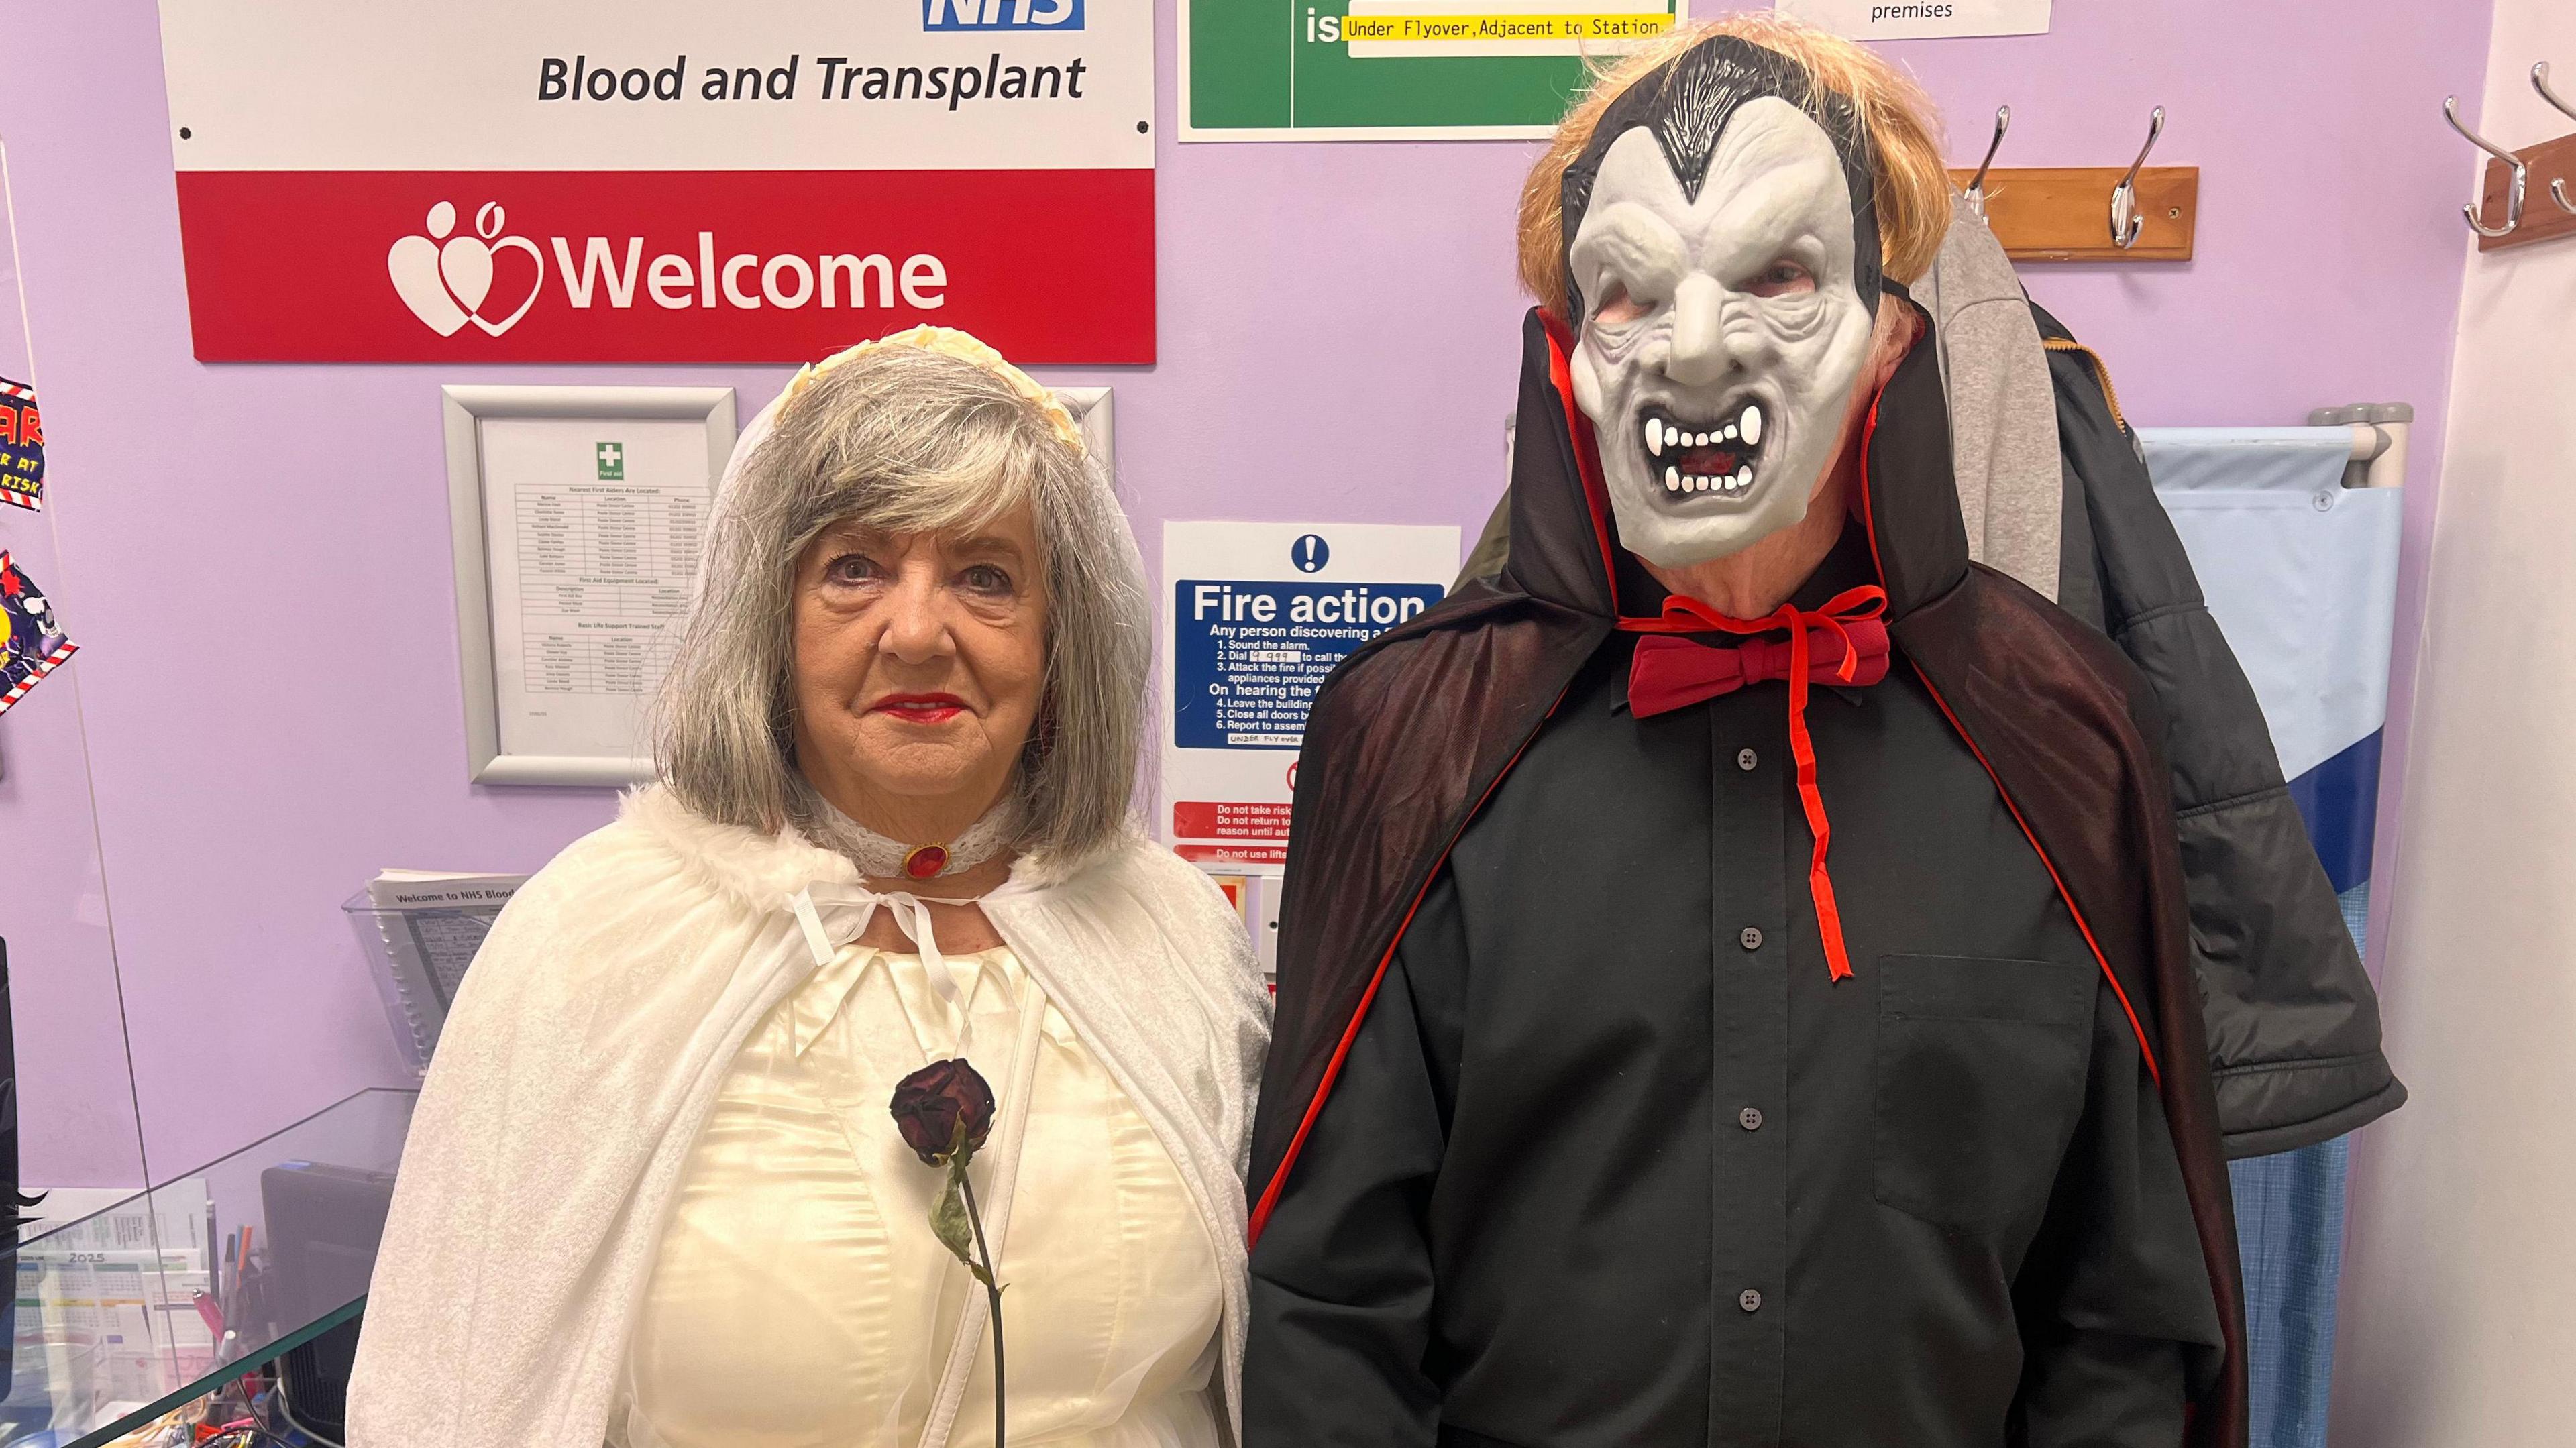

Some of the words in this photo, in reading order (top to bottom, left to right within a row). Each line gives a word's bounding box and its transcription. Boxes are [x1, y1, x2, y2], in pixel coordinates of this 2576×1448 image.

[1872, 1, 1953, 23] premises
[1307, 8, 1340, 42] is
[1348, 20, 1393, 36] Under
[1564, 21, 1582, 36] to
[537, 55, 686, 101] Blood
[701, 54, 799, 101] and
[816, 53, 1086, 111] Transplant
[551, 231, 947, 309] Welcome
[17, 457, 39, 472] AT
[2, 474, 40, 494] RISK
[1194, 585, 1277, 622] Fire
[1290, 587, 1426, 624] action
[1210, 625, 1236, 638] Any
[1240, 628, 1287, 639] person
[1290, 626, 1369, 642] discovering
[1218, 641, 1226, 649] 1.
[1229, 641, 1260, 650] Sound
[1262, 641, 1277, 650] the
[1280, 641, 1310, 651] alarm.
[1217, 651, 1226, 660] 2.
[1229, 651, 1247, 661] Dial
[1302, 653, 1312, 661] to
[1315, 652, 1332, 662] call
[1217, 663, 1226, 671] 3.
[1229, 663, 1259, 672] Attack
[1261, 663, 1277, 672] the
[1279, 663, 1295, 673] fire
[1297, 663, 1305, 673] if
[1228, 674, 1280, 685] appliances
[1282, 675, 1325, 685] provided
[1209, 683, 1228, 695] On
[1236, 685, 1287, 699] hearing
[1290, 685, 1311, 697] the
[1216, 698, 1226, 708] 4.
[1227, 699, 1256, 708] Leave
[1258, 700, 1273, 708] the
[1216, 710, 1226, 718] 5.
[1227, 710, 1254, 719] Close
[1256, 710, 1268, 719] all
[1271, 710, 1298, 720] doors
[1216, 720, 1226, 729] 6.
[1227, 720, 1259, 731] Report
[1262, 722, 1271, 730] to
[1230, 734, 1259, 742] UNDER
[1217, 805, 1230, 814] Do
[1233, 805, 1248, 814] not
[1251, 805, 1271, 815] take
[1217, 816, 1230, 824] Do
[1233, 816, 1248, 825] not
[1250, 817, 1279, 826] return
[1282, 817, 1291, 826] to
[1252, 827, 1273, 836] until
[1216, 849, 1230, 858] Do
[1232, 850, 1248, 858] not
[1270, 850, 1287, 859] lifts
[396, 893, 444, 903] Welcome
[446, 893, 458, 901] to
[461, 890, 482, 900] NHS
[485, 889, 515, 899] Blood
